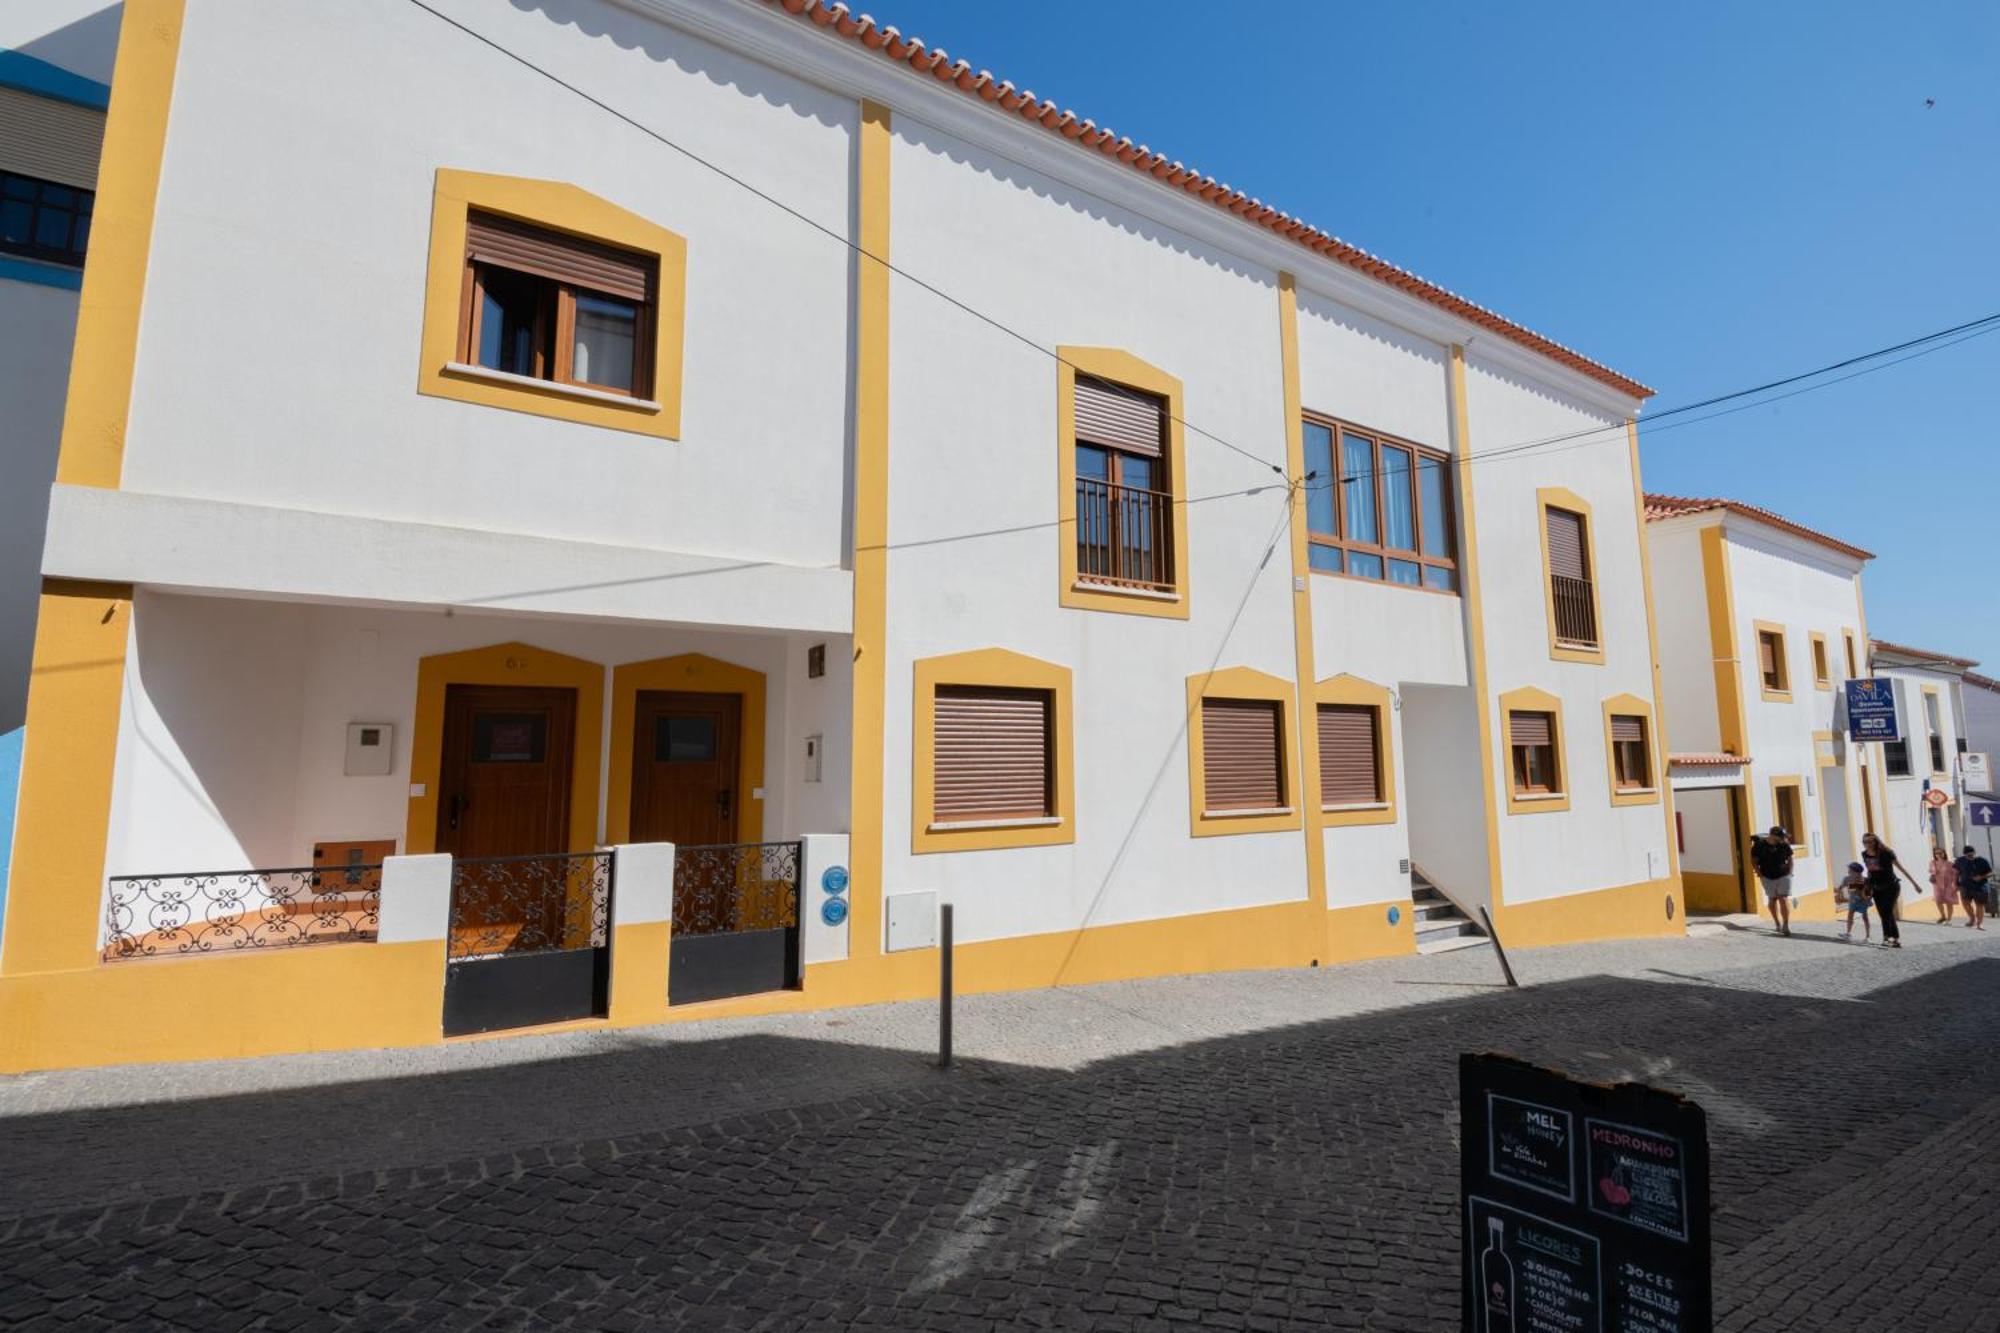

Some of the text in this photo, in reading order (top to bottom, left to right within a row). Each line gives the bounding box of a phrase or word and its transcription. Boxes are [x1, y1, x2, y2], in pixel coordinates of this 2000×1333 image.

[1526, 1110, 1562, 1131] MEL
[1591, 1128, 1675, 1160] MEDRONHO
[1518, 1226, 1581, 1260] LICORES
[1527, 1272, 1590, 1302] MEDRONHO
[1625, 1262, 1674, 1291] DOCES
